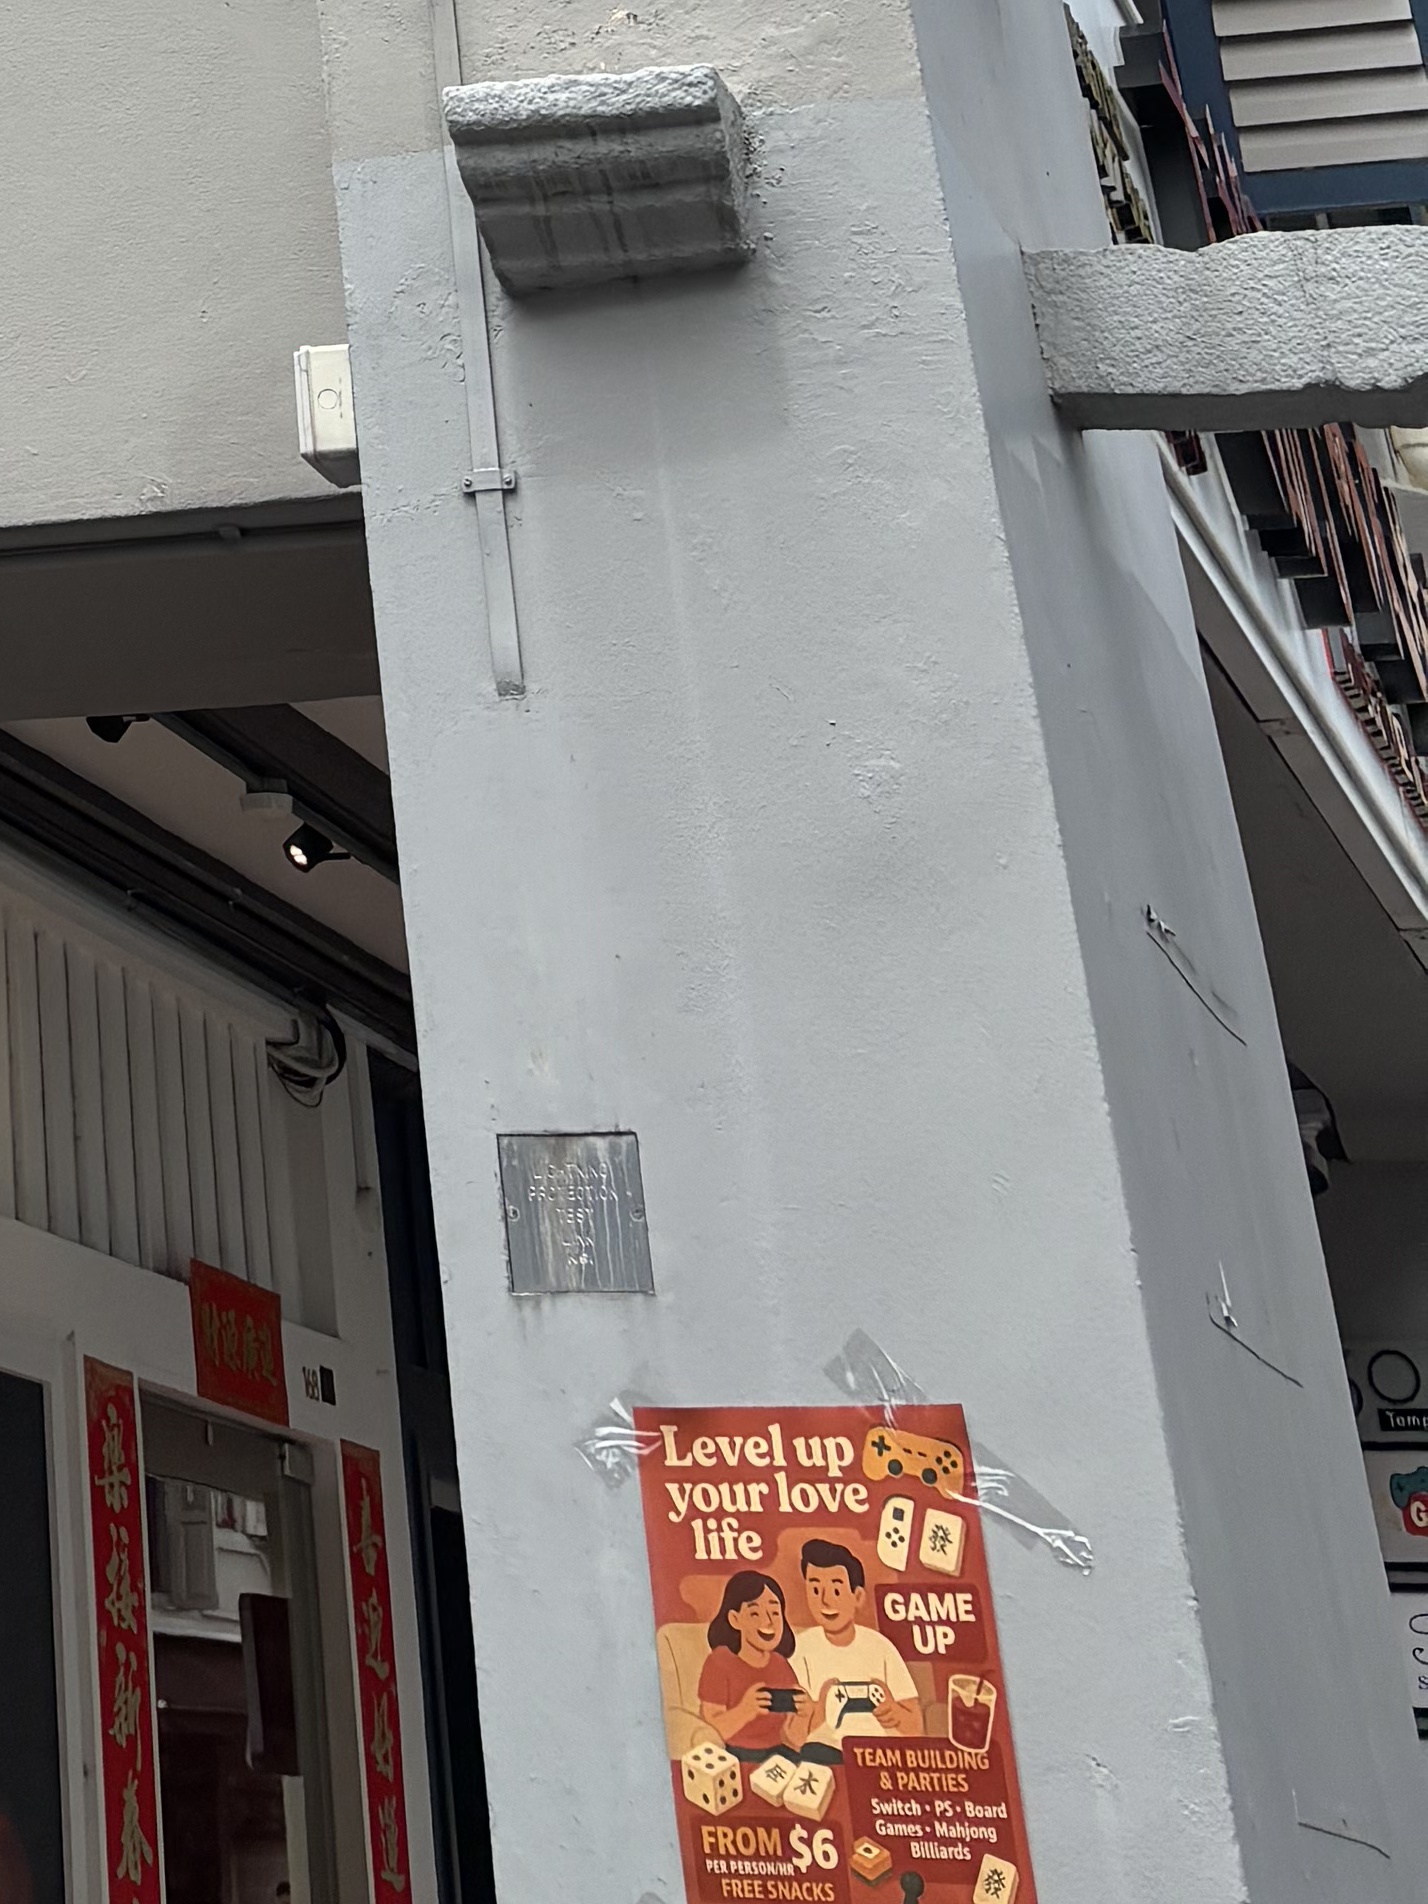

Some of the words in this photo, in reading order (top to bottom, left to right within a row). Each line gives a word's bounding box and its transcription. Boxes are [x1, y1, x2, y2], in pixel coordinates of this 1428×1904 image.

[659, 1423, 787, 1468] Level
[794, 1435, 855, 1477] up
[664, 1480, 770, 1523] your
[774, 1471, 871, 1514] love
[690, 1517, 763, 1561] life
[883, 1592, 976, 1623] GAME
[94, 1402, 154, 1904] 樂接新春
[911, 1624, 956, 1655] UP
[853, 1747, 901, 1768] TEAM
[906, 1749, 990, 1771] BUILDING
[879, 1772, 892, 1790] &
[897, 1772, 969, 1792] PARTIES
[870, 1798, 922, 1816] Switch
[934, 1800, 953, 1817] PS
[964, 1801, 1008, 1819] Board
[875, 1819, 923, 1837] Games
[934, 1821, 997, 1843] Mahjong
[700, 1825, 782, 1857] FROM
[789, 1823, 839, 1874] $6
[910, 1841, 972, 1860] Billiards
[706, 1859, 728, 1874] PER
[730, 1860, 795, 1876] PERSON/HR
[721, 1878, 765, 1900] FREE
[767, 1880, 836, 1902] SNACKS
